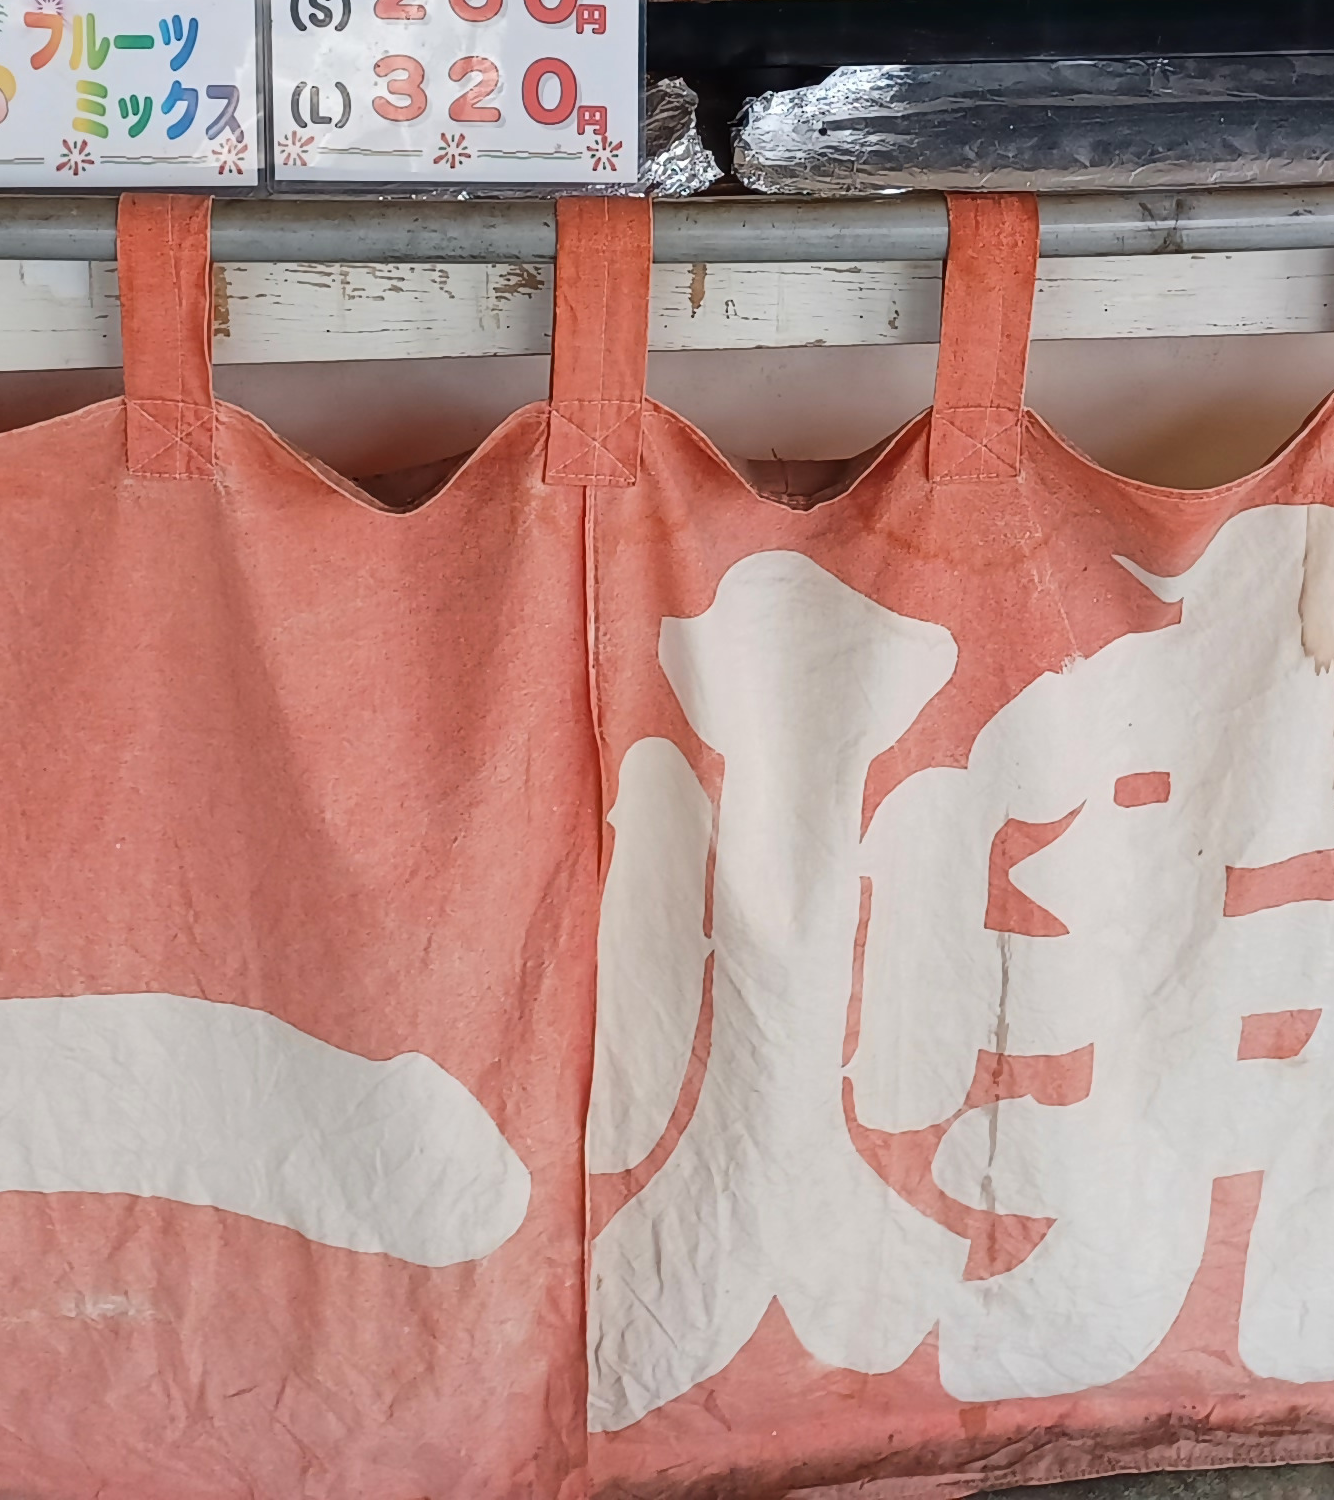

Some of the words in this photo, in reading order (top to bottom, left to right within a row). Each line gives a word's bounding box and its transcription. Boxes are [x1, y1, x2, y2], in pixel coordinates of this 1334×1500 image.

[23, 12, 199, 72] フルーツ
[71, 80, 244, 144] ミックス
[290, 80, 353, 129] (L)
[371, 54, 608, 136] 320円
